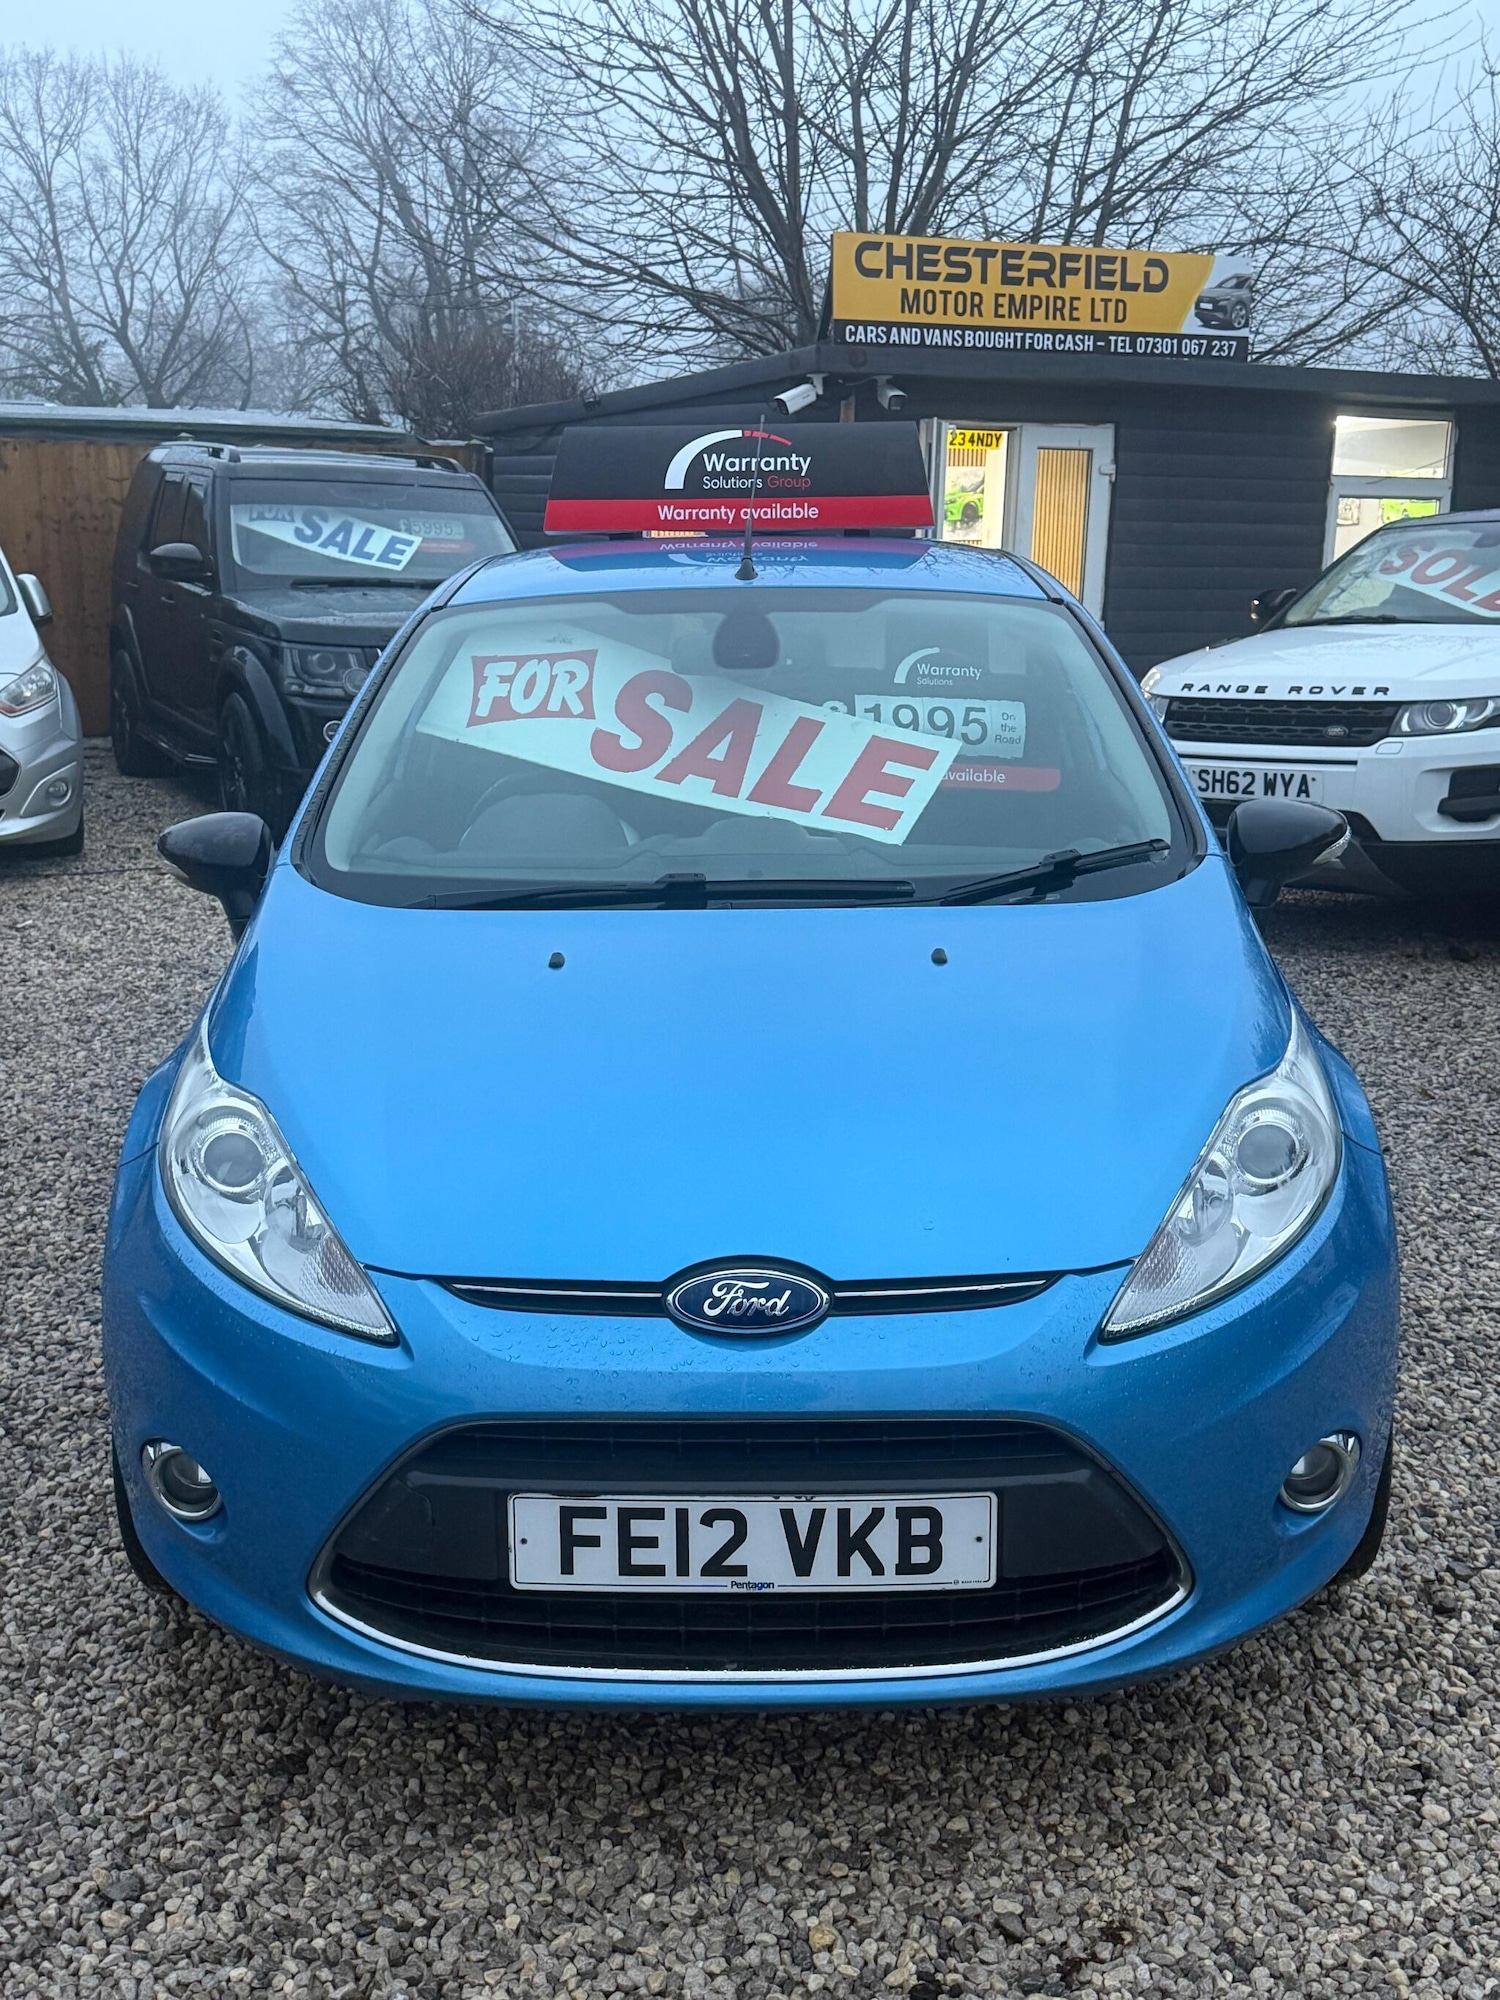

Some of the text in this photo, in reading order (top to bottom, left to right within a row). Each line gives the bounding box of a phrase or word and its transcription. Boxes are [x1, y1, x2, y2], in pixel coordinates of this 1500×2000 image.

[854, 241, 1170, 294] CHESTERFIELD
[900, 288, 1127, 324] MOTOR EMPIRE LTD
[845, 325, 887, 344] CARS
[889, 327, 921, 345] AND
[923, 328, 963, 347] VANS
[964, 331, 1024, 350] BOUGHT
[1025, 333, 1054, 351] FOR
[1055, 334, 1093, 351] CASH
[1108, 336, 1133, 353] TEL
[1136, 337, 1178, 354] 07301
[1181, 339, 1208, 355] 067
[1211, 340, 1237, 357] 237
[703, 453, 812, 476] Warranty
[702, 475, 811, 490] Solutions Group
[657, 503, 819, 524] Warranty available
[293, 507, 415, 566] SALE
[916, 663, 982, 680] Warranty
[916, 677, 954, 687] Solutions
[1180, 682, 1391, 696] RANGE ROVER
[1000, 722, 1017, 732] the
[1001, 711, 1016, 721] On
[474, 656, 940, 831] FOR SALE
[994, 734, 1022, 744] Road
[1197, 768, 1311, 798] SH62 WYA
[703, 1279, 792, 1317] Ford
[559, 1505, 944, 1577] FE12 VKB
[730, 1580, 775, 1591] Pentagon
